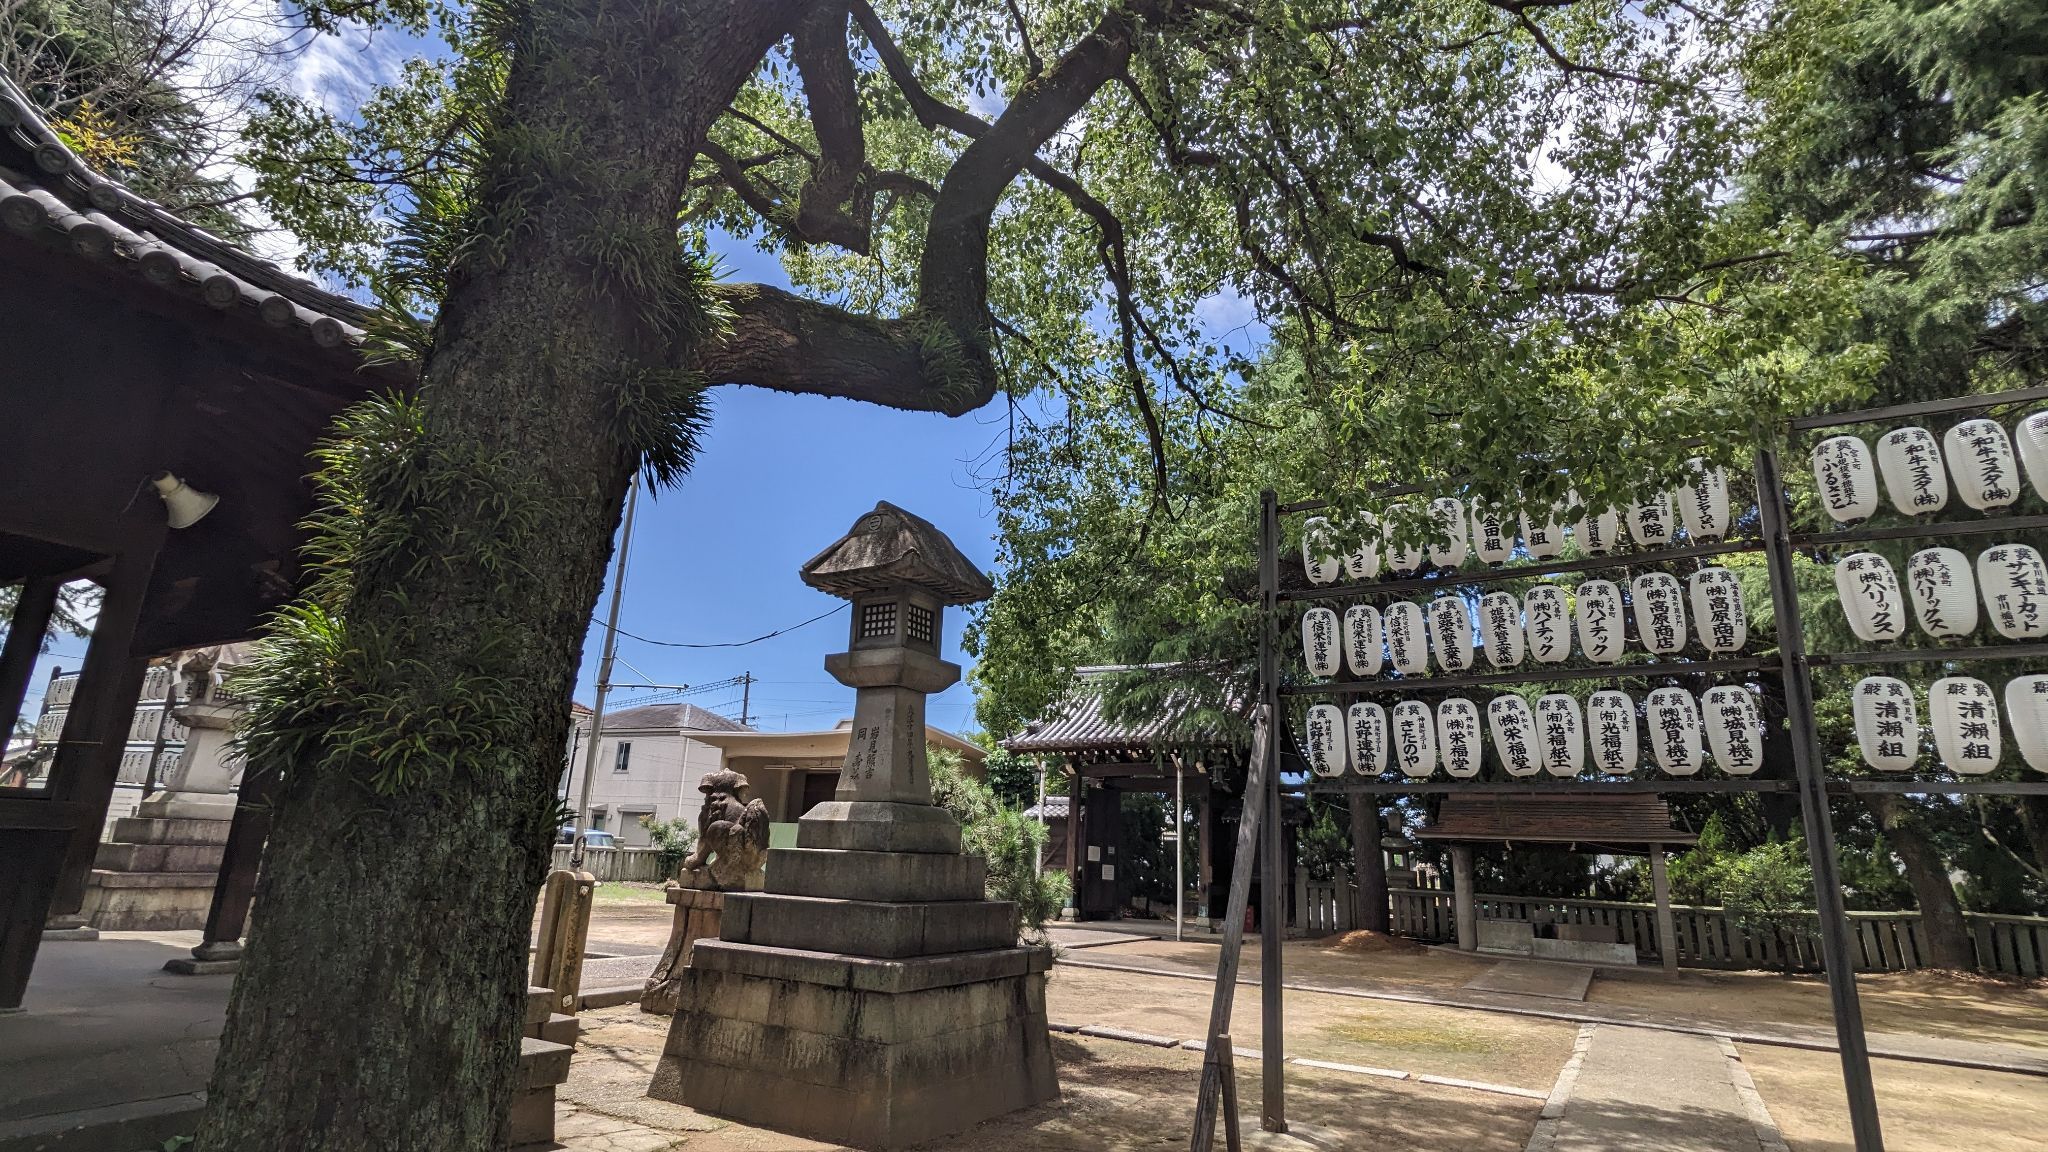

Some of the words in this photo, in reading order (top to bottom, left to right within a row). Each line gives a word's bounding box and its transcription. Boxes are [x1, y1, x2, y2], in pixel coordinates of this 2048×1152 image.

[1822, 458, 1846, 509] ふるさと
[1483, 515, 1504, 551] 金田組
[2005, 561, 2039, 631] サンキューカット
[1400, 720, 1420, 768] きたのや
